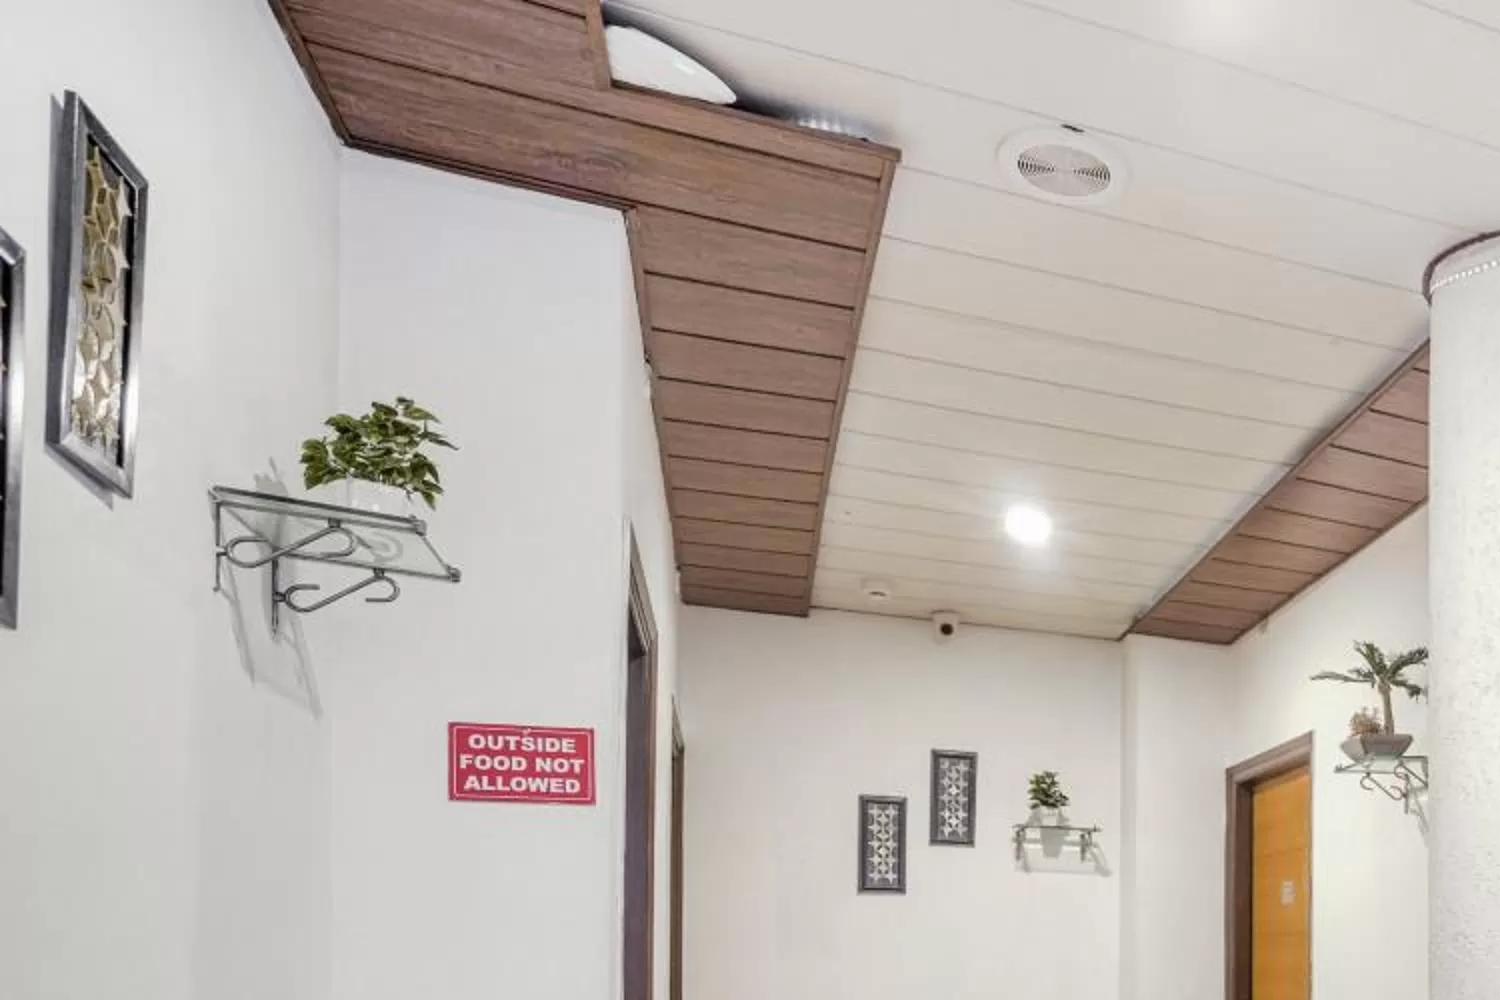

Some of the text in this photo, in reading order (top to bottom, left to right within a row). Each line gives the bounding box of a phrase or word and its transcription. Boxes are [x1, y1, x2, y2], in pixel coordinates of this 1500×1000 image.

[468, 734, 576, 753] OUTSIDE
[459, 753, 585, 774] FOOD NOT
[464, 775, 581, 793] ALLOWED
